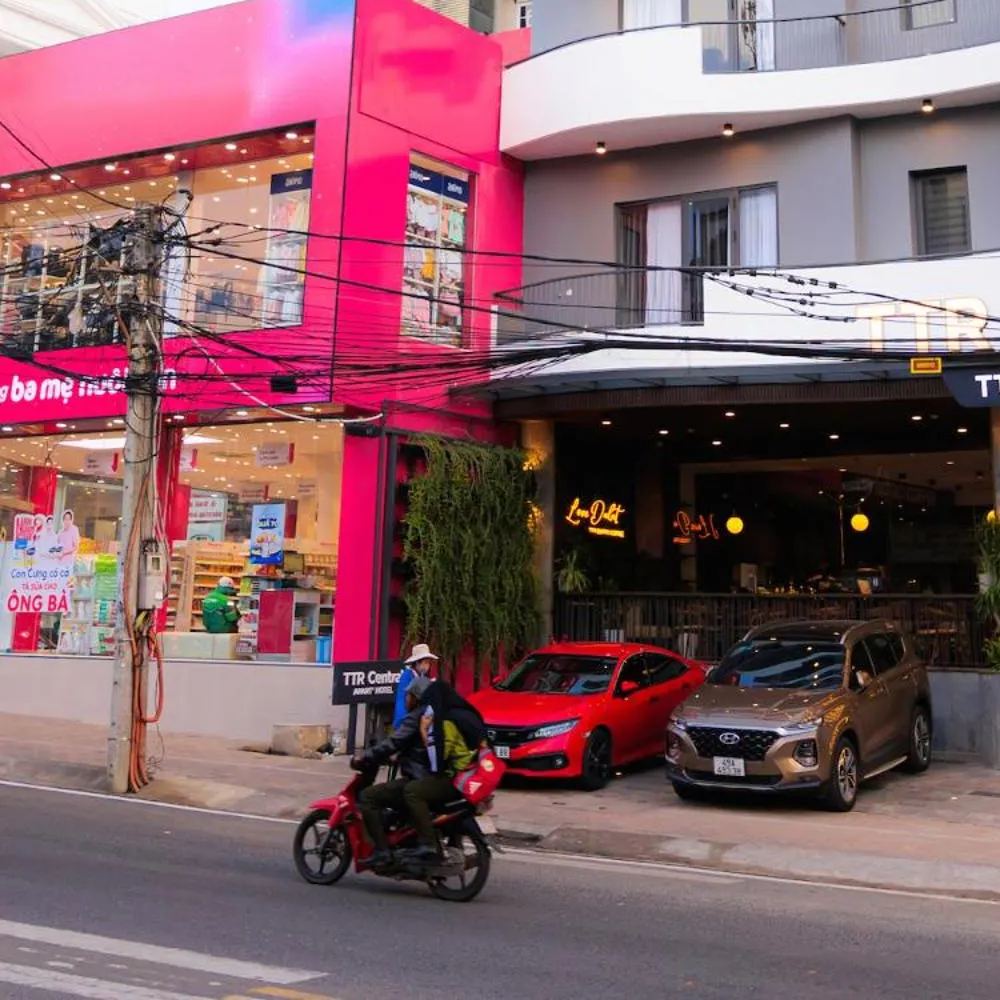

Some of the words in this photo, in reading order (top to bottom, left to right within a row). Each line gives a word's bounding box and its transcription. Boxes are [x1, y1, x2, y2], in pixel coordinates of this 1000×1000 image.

[855, 296, 996, 353] TTR
[10, 375, 37, 402] ba
[40, 377, 74, 404] mẹ
[7, 589, 43, 611] ÔNG
[47, 588, 68, 611] BÀ
[342, 671, 366, 687] TTR
[367, 669, 403, 685] Centra
